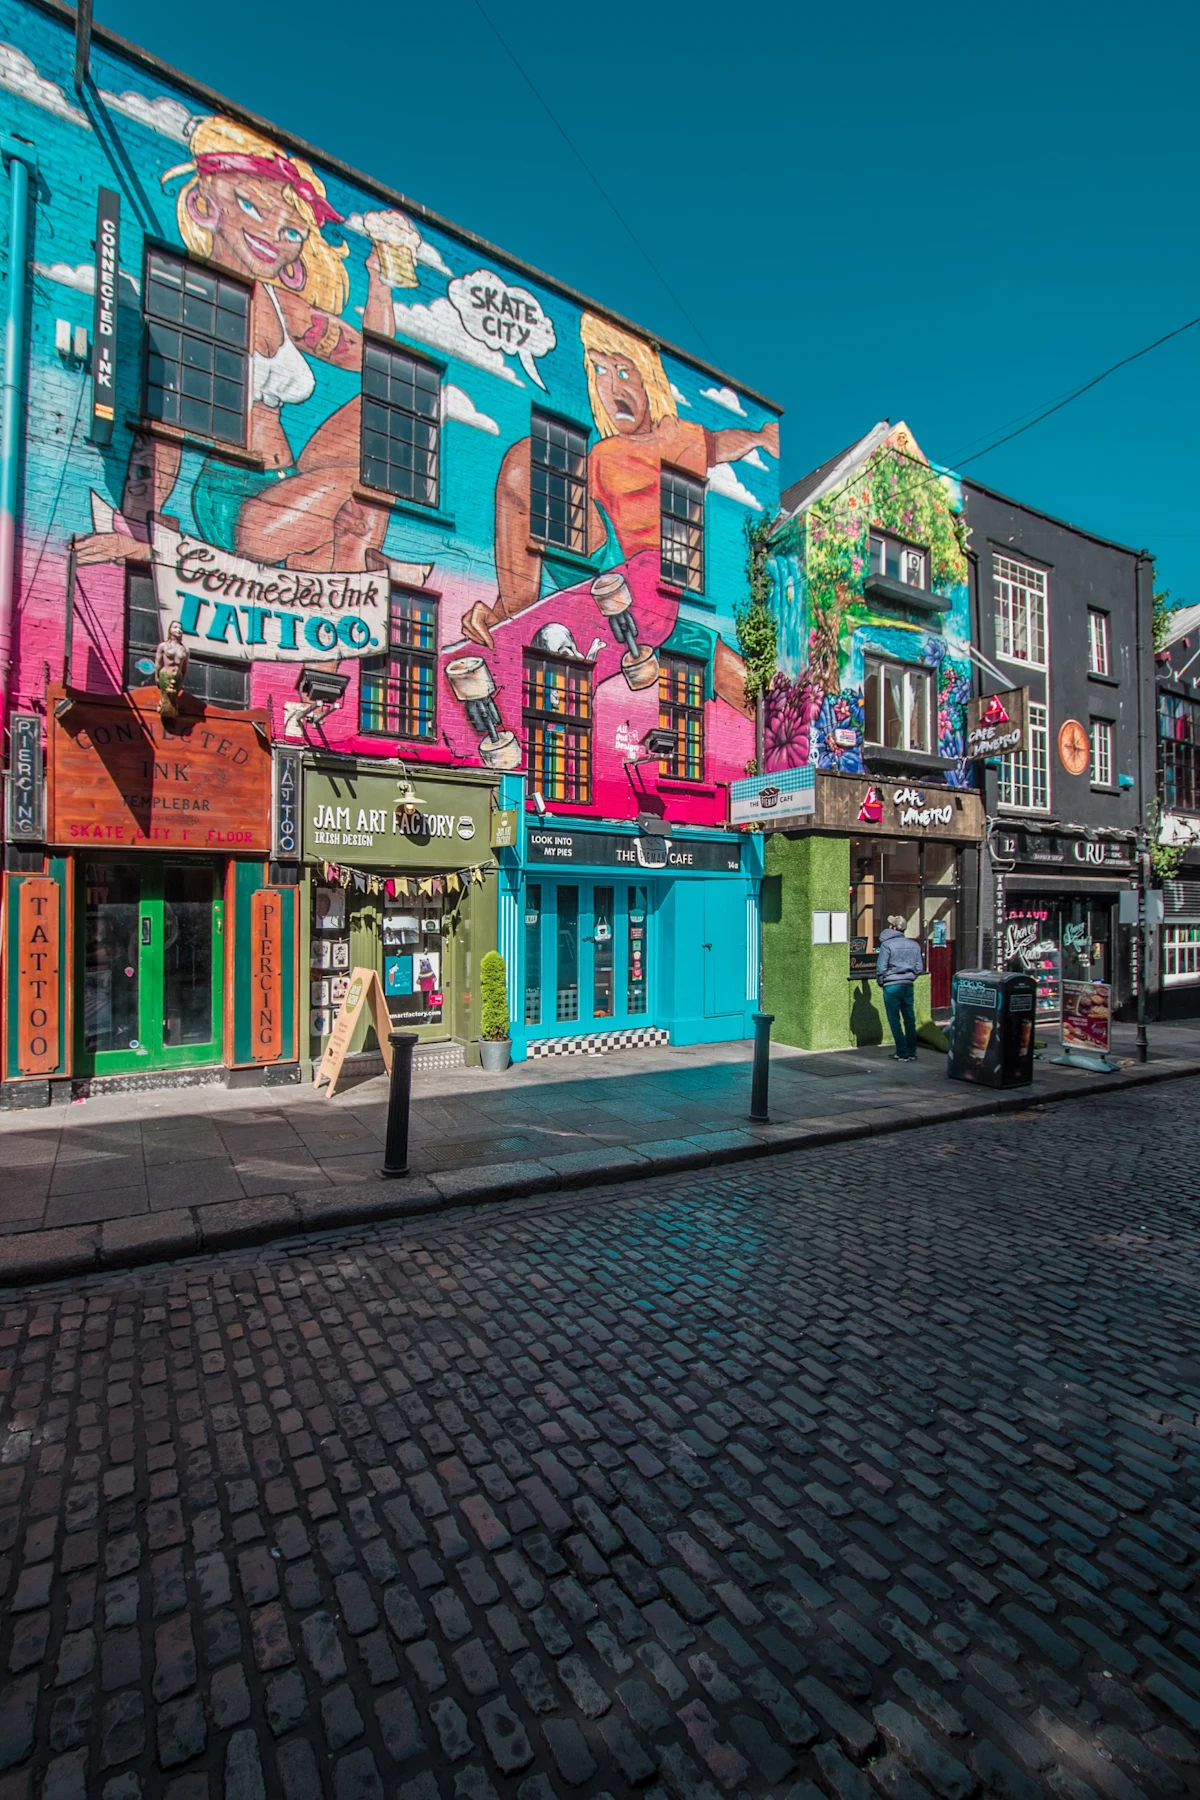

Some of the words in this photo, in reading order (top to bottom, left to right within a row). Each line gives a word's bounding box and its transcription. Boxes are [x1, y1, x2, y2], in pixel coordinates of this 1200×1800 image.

[99, 219, 116, 336] CONNECTED
[470, 286, 538, 325] SKATE
[482, 316, 531, 346] CITY
[98, 347, 112, 388] INK
[175, 541, 324, 608] Connected
[328, 574, 379, 610] Ink
[75, 721, 250, 766] CONNECTED
[968, 726, 996, 743] CAFE
[18, 721, 33, 833] PIERCING
[142, 760, 190, 782] INK
[122, 795, 210, 811] TEMPLEBAR
[280, 756, 295, 851] TATTOO
[779, 795, 794, 803] CAFE
[893, 787, 925, 807] CAFE
[70, 825, 124, 839] SKATE
[208, 830, 253, 843] FLOOR
[313, 804, 351, 831] JAM
[356, 808, 388, 834] ART
[392, 811, 455, 838] FACTORY
[314, 832, 340, 845] IRISH
[342, 833, 373, 847] DESIGN
[531, 834, 553, 845] LOOK
[554, 836, 573, 846] INTO
[543, 847, 557, 857] MY
[557, 847, 573, 857] PIES
[1003, 839, 1015, 853] 12
[1074, 840, 1105, 864] CRU
[616, 849, 636, 863] THE
[669, 853, 694, 865] CAFE
[996, 875, 1004, 924] TATTOO
[850, 941, 867, 950] PEN
[996, 931, 1004, 972] PIERC
[29, 897, 49, 1056] TATTOO
[259, 904, 275, 1044] PIERCING
[1131, 936, 1139, 997] PIERCING
